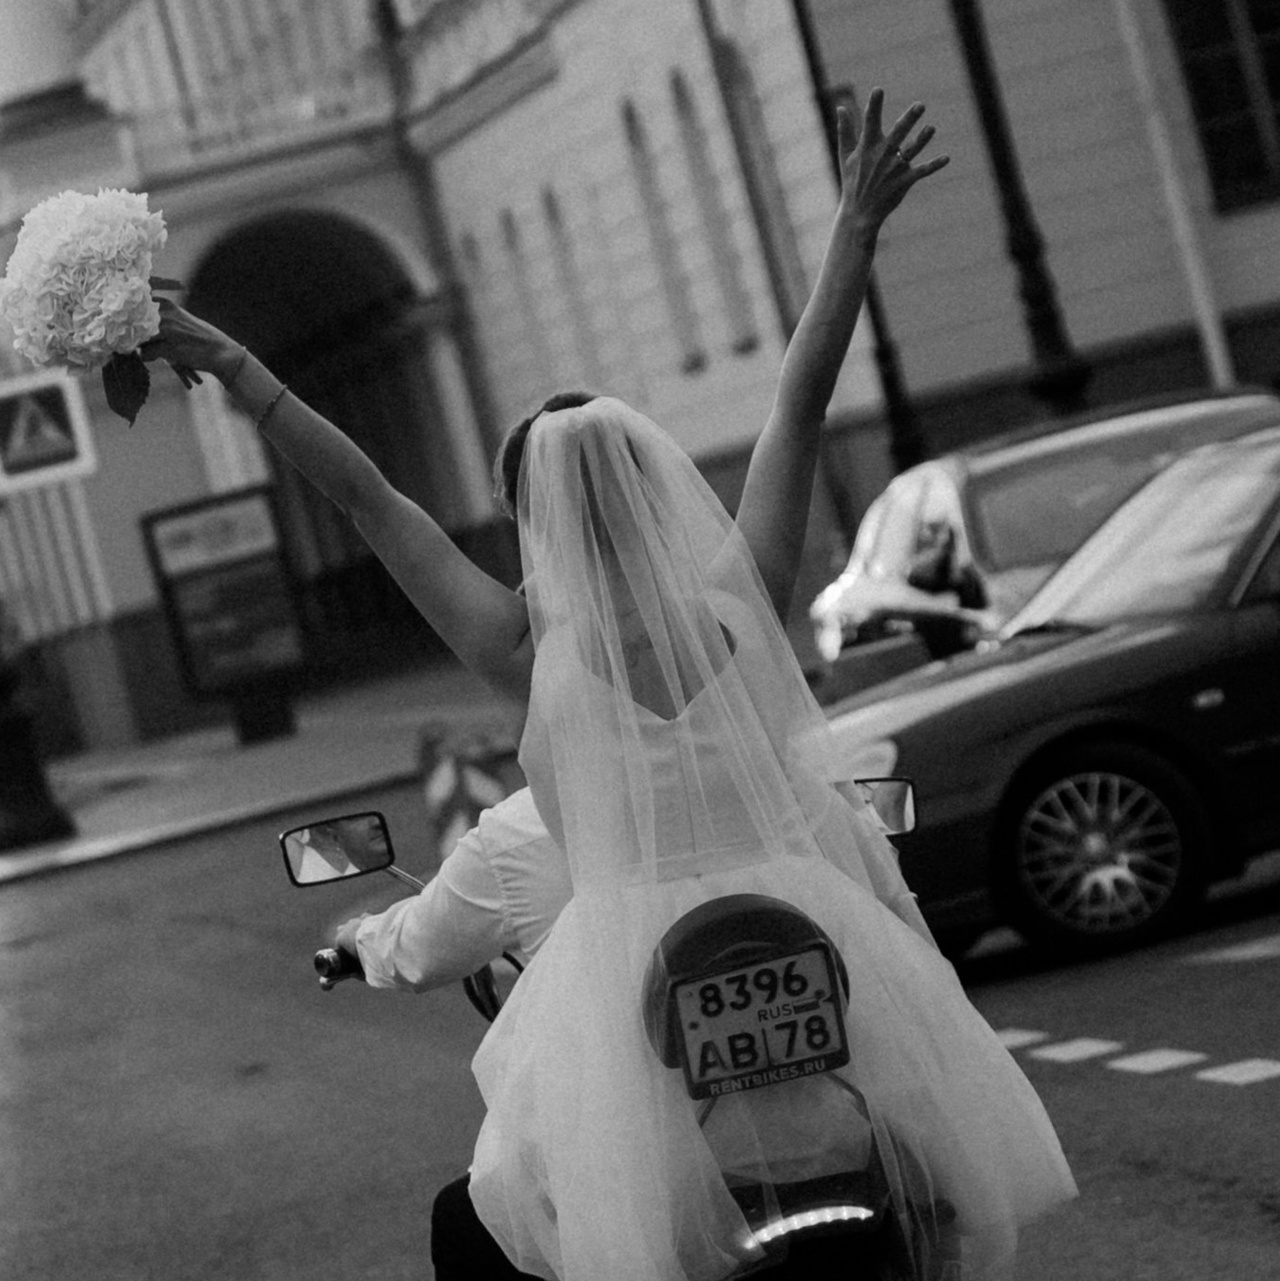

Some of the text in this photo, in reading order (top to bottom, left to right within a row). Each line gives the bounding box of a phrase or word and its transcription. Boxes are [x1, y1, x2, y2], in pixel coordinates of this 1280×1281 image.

[699, 961, 808, 1017] 8396
[756, 1003, 793, 1022] RUS
[774, 1015, 831, 1059] 78
[710, 1059, 825, 1095] RENTBIKES.RU
